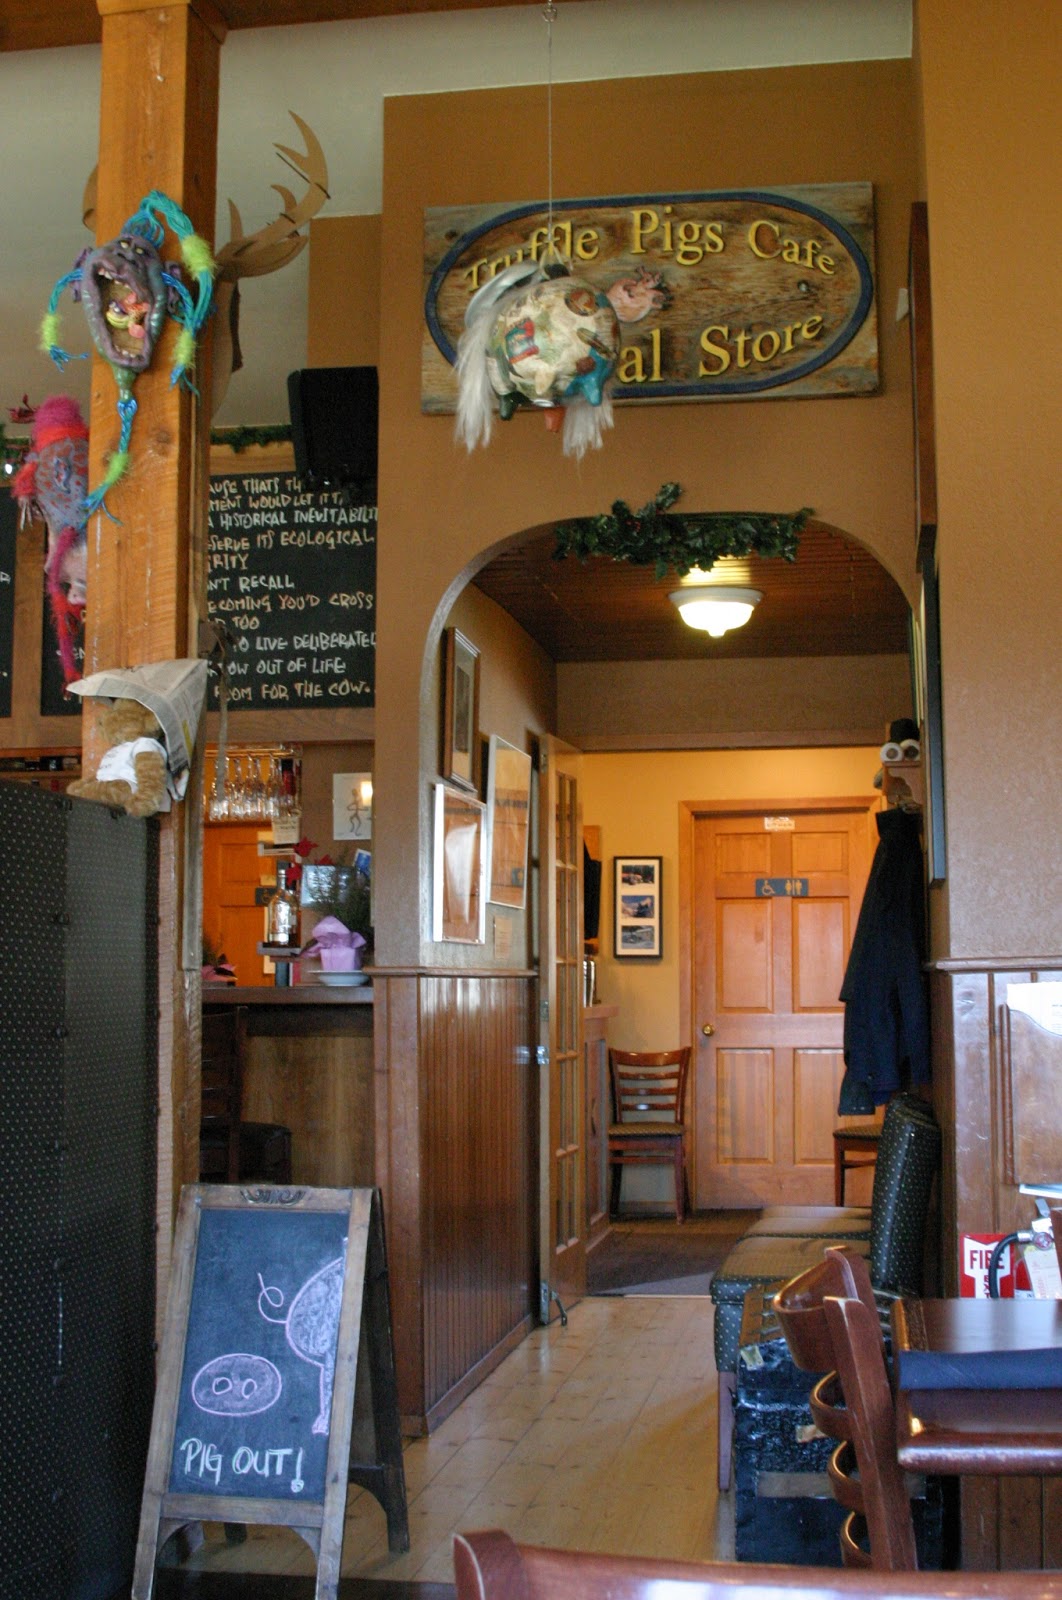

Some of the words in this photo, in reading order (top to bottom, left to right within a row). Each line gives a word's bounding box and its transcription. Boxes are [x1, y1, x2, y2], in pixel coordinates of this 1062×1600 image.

[630, 206, 725, 266] Pigs
[748, 220, 836, 275] Cafe
[698, 315, 824, 379] Store
[249, 493, 291, 509] WOULD
[293, 492, 315, 507] LET
[220, 511, 288, 531] HISTORICAL
[280, 528, 375, 550] ECOLOGICAL
[239, 574, 295, 593] RECALL
[278, 593, 320, 610] YOU'D
[329, 591, 374, 610] CROSS
[231, 614, 260, 631] TOO
[255, 636, 289, 651] LIVE
[293, 630, 376, 653] DELIBERATEL
[256, 659, 284, 675] OUT
[286, 657, 307, 673] OF
[312, 656, 347, 674] LIFE
[261, 683, 290, 701] FOR
[294, 680, 323, 699] THE
[180, 1437, 224, 1486] PIG
[231, 1446, 305, 1493] OUT!
